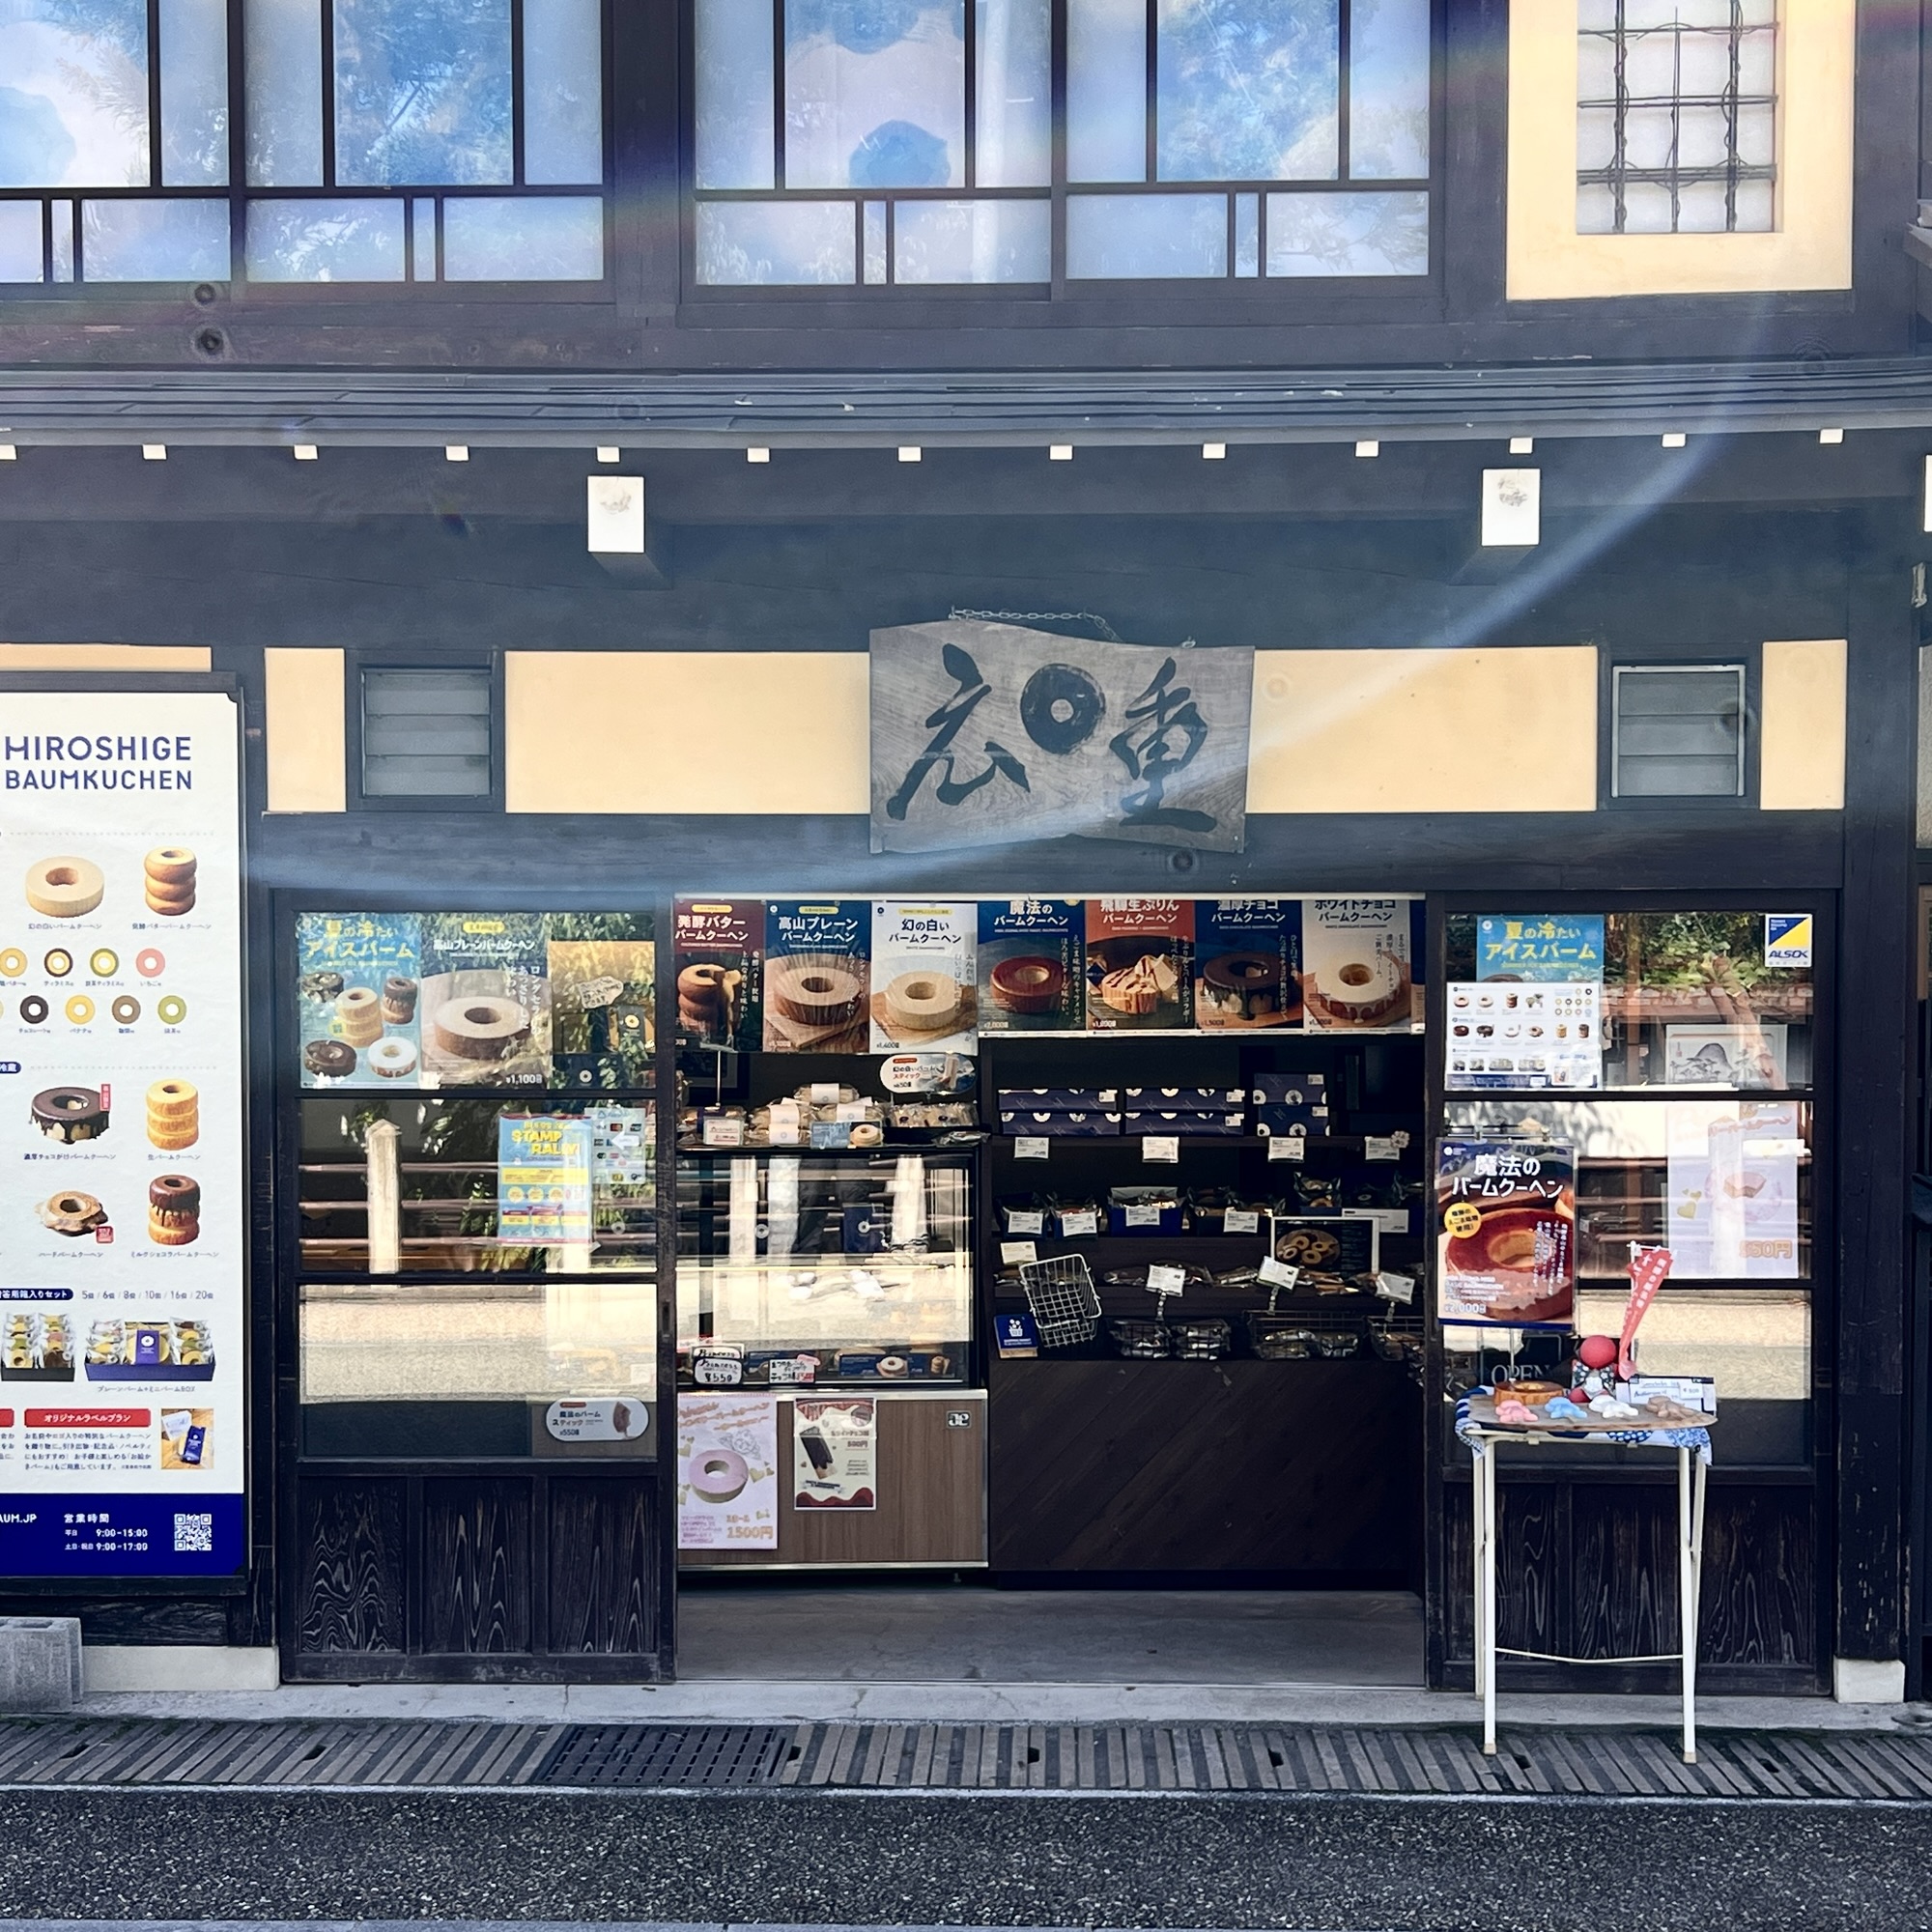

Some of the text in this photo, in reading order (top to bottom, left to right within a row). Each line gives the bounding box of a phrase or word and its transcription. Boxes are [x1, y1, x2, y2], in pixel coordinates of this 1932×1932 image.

[5, 736, 191, 760] HIROSHIGE
[6, 770, 192, 789] BAUMKUCHEN
[1009, 900, 1052, 915] 魔法の
[677, 915, 746, 929] 発酵バター
[779, 917, 858, 930] 高山プレーン
[994, 915, 1068, 926] バームクーヘン
[1102, 913, 1178, 924] バームクーヘン
[1211, 913, 1286, 923] バームクーヘン
[1319, 913, 1392, 923] バームクーヘン
[901, 919, 950, 931] 幻の白い
[1504, 921, 1581, 940] 夏の冷たい
[675, 930, 749, 941] バームクーヘン
[781, 931, 856, 943] バームクーヘン
[889, 933, 962, 944] バームクーヘン
[304, 940, 414, 958] アイスバーム
[433, 939, 535, 951] 高山プレーンバームクーヘン
[1485, 942, 1597, 960] アイスバーム
[1768, 950, 1808, 958] ALSOK
[1474, 1154, 1541, 1178] 魔法の
[1452, 1177, 1564, 1199] バームクーヘン
[64, 1513, 109, 1523] 営業時間
[96, 1528, 148, 1537] 9:00-15:00
[96, 1542, 148, 1551] 9:00-17:00
